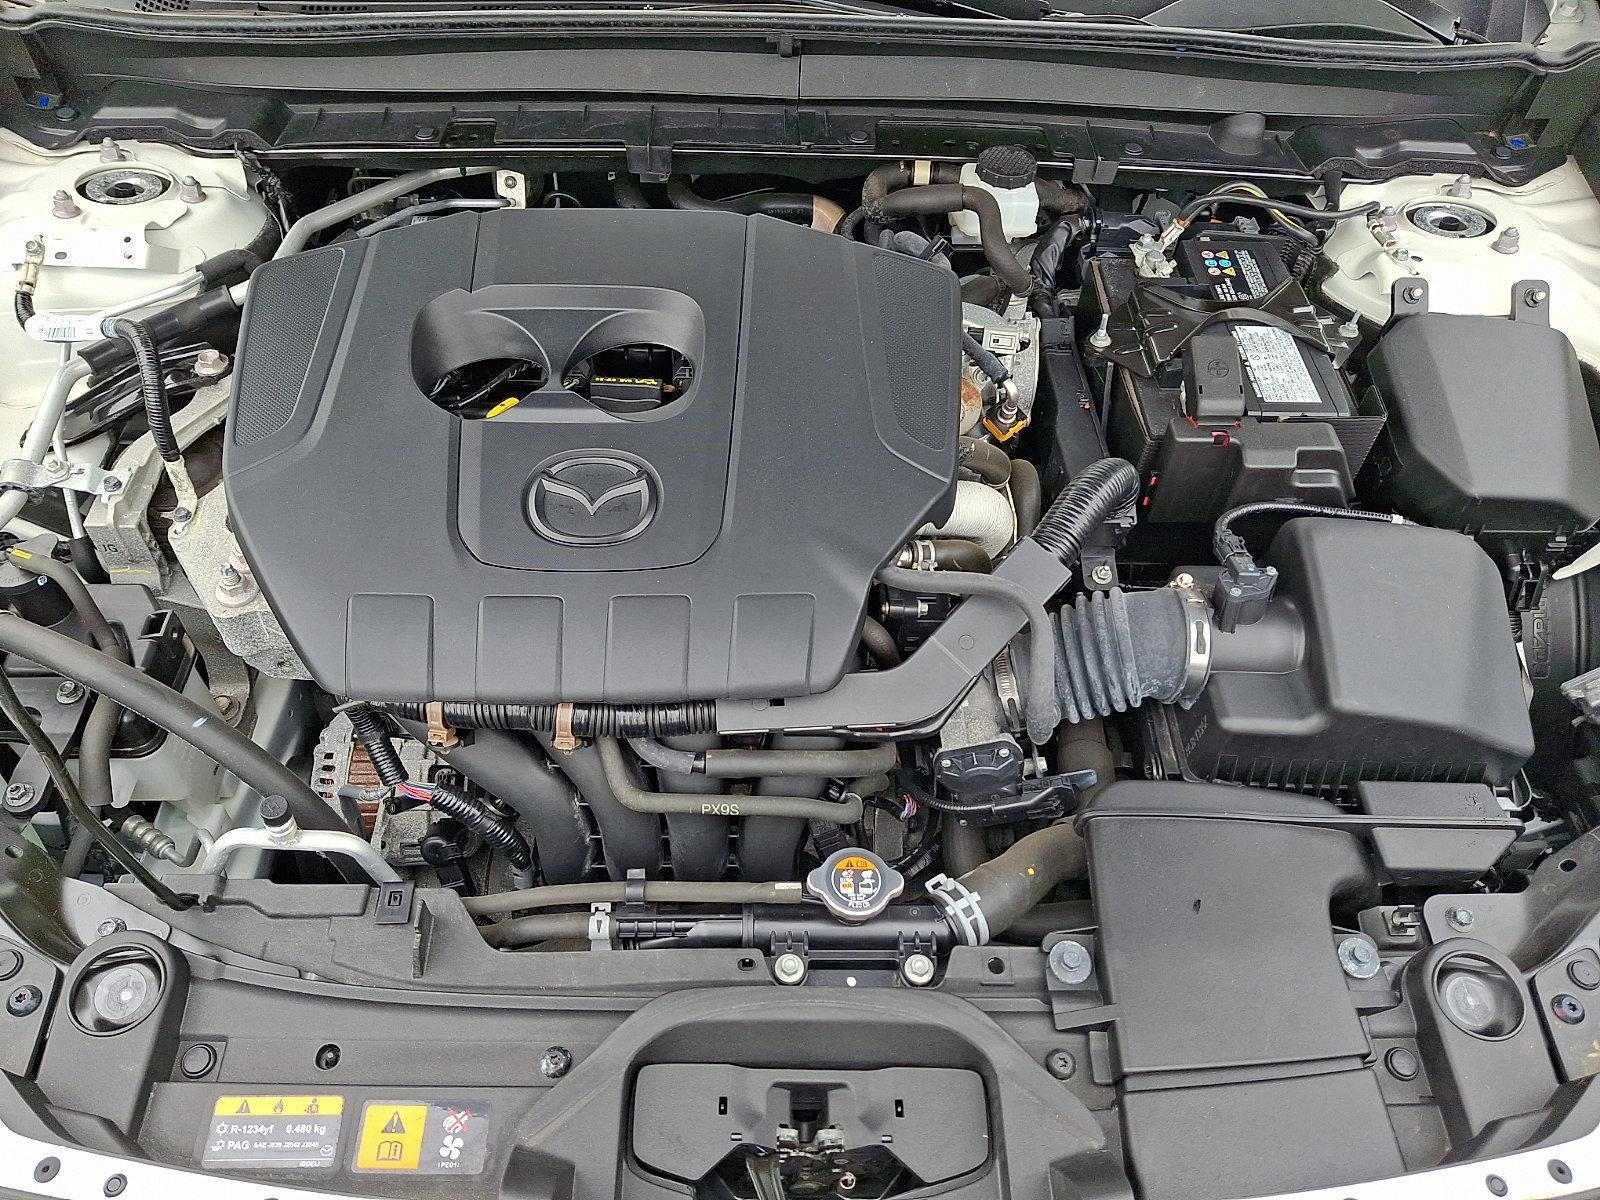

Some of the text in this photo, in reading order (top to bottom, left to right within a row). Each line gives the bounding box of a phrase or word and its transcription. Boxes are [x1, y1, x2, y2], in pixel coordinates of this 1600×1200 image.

[701, 803, 740, 816] PX9S
[230, 1123, 327, 1136] R-1234yf 0.480 kg
[226, 1140, 250, 1151] PAG
[253, 1141, 267, 1149] SAE
